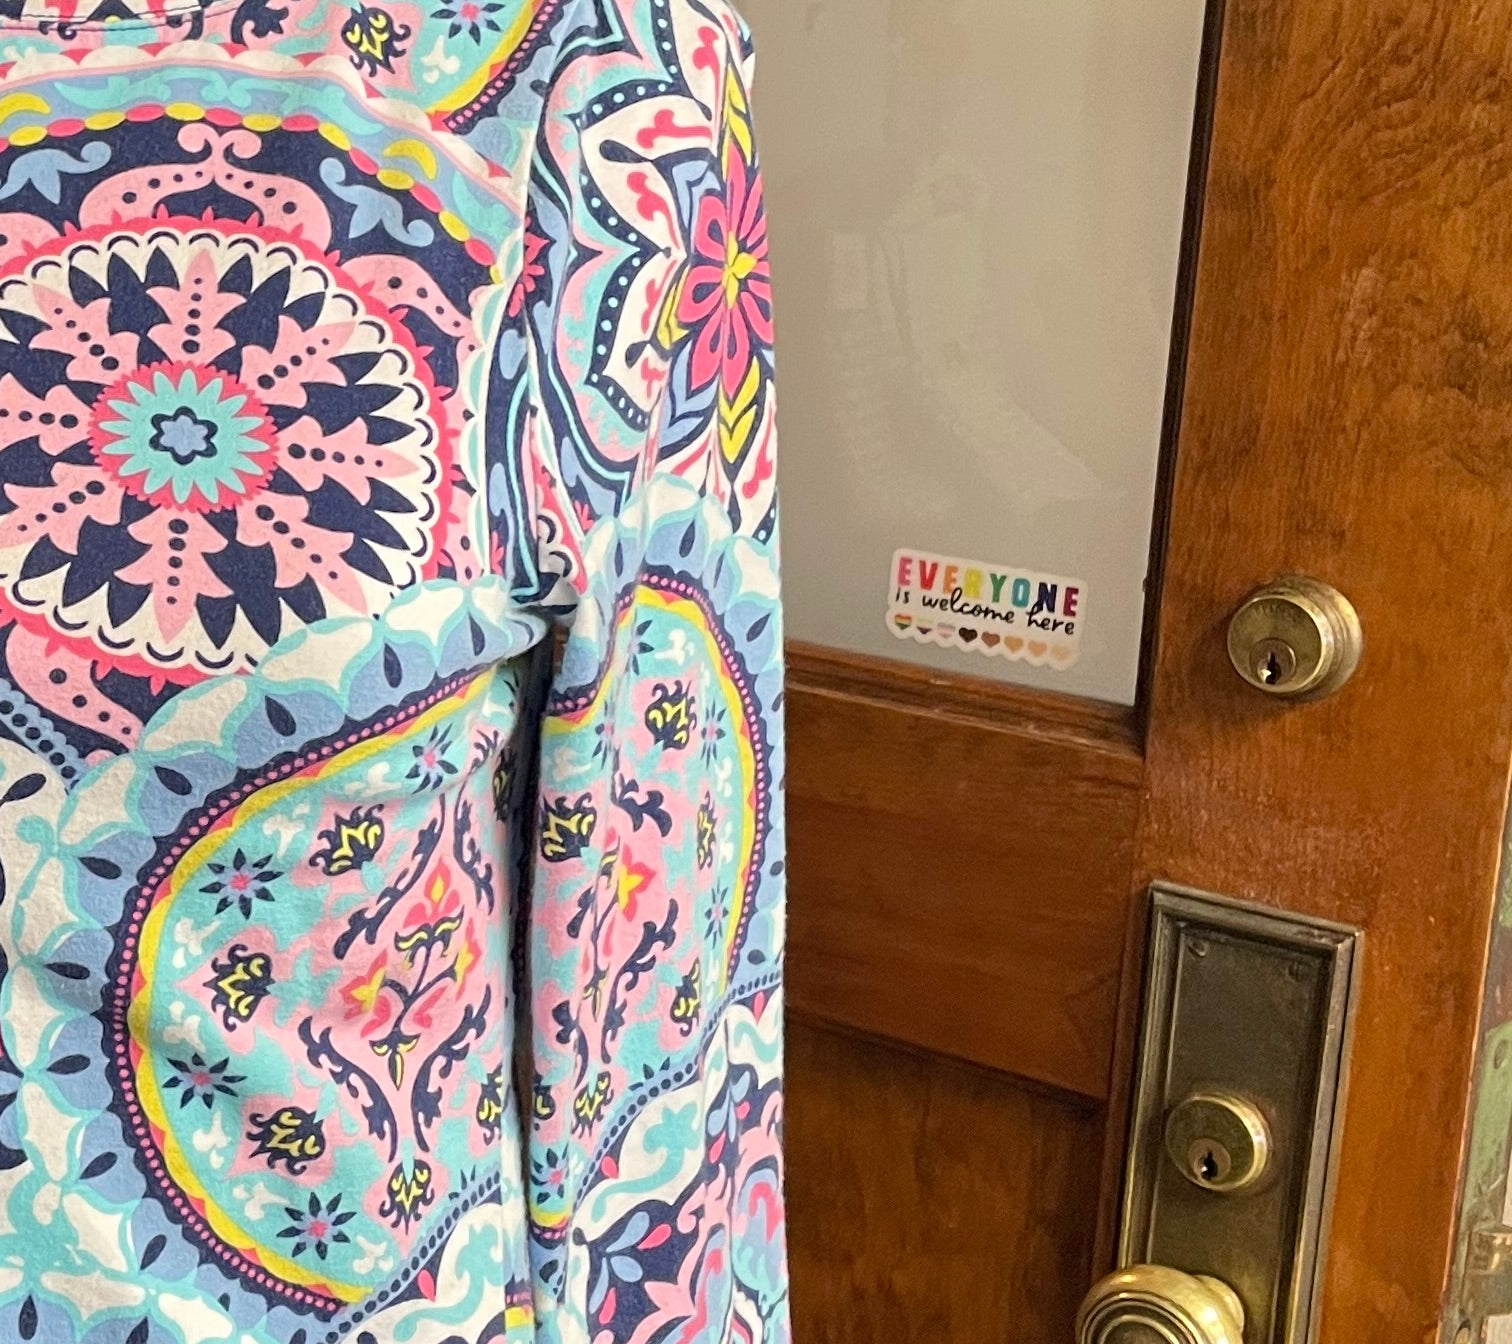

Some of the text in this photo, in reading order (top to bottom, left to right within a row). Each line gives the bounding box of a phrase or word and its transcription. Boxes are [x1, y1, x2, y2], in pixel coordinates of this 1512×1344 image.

[895, 587, 1076, 635] is welcome here
[897, 557, 1080, 617] EVERYONE
